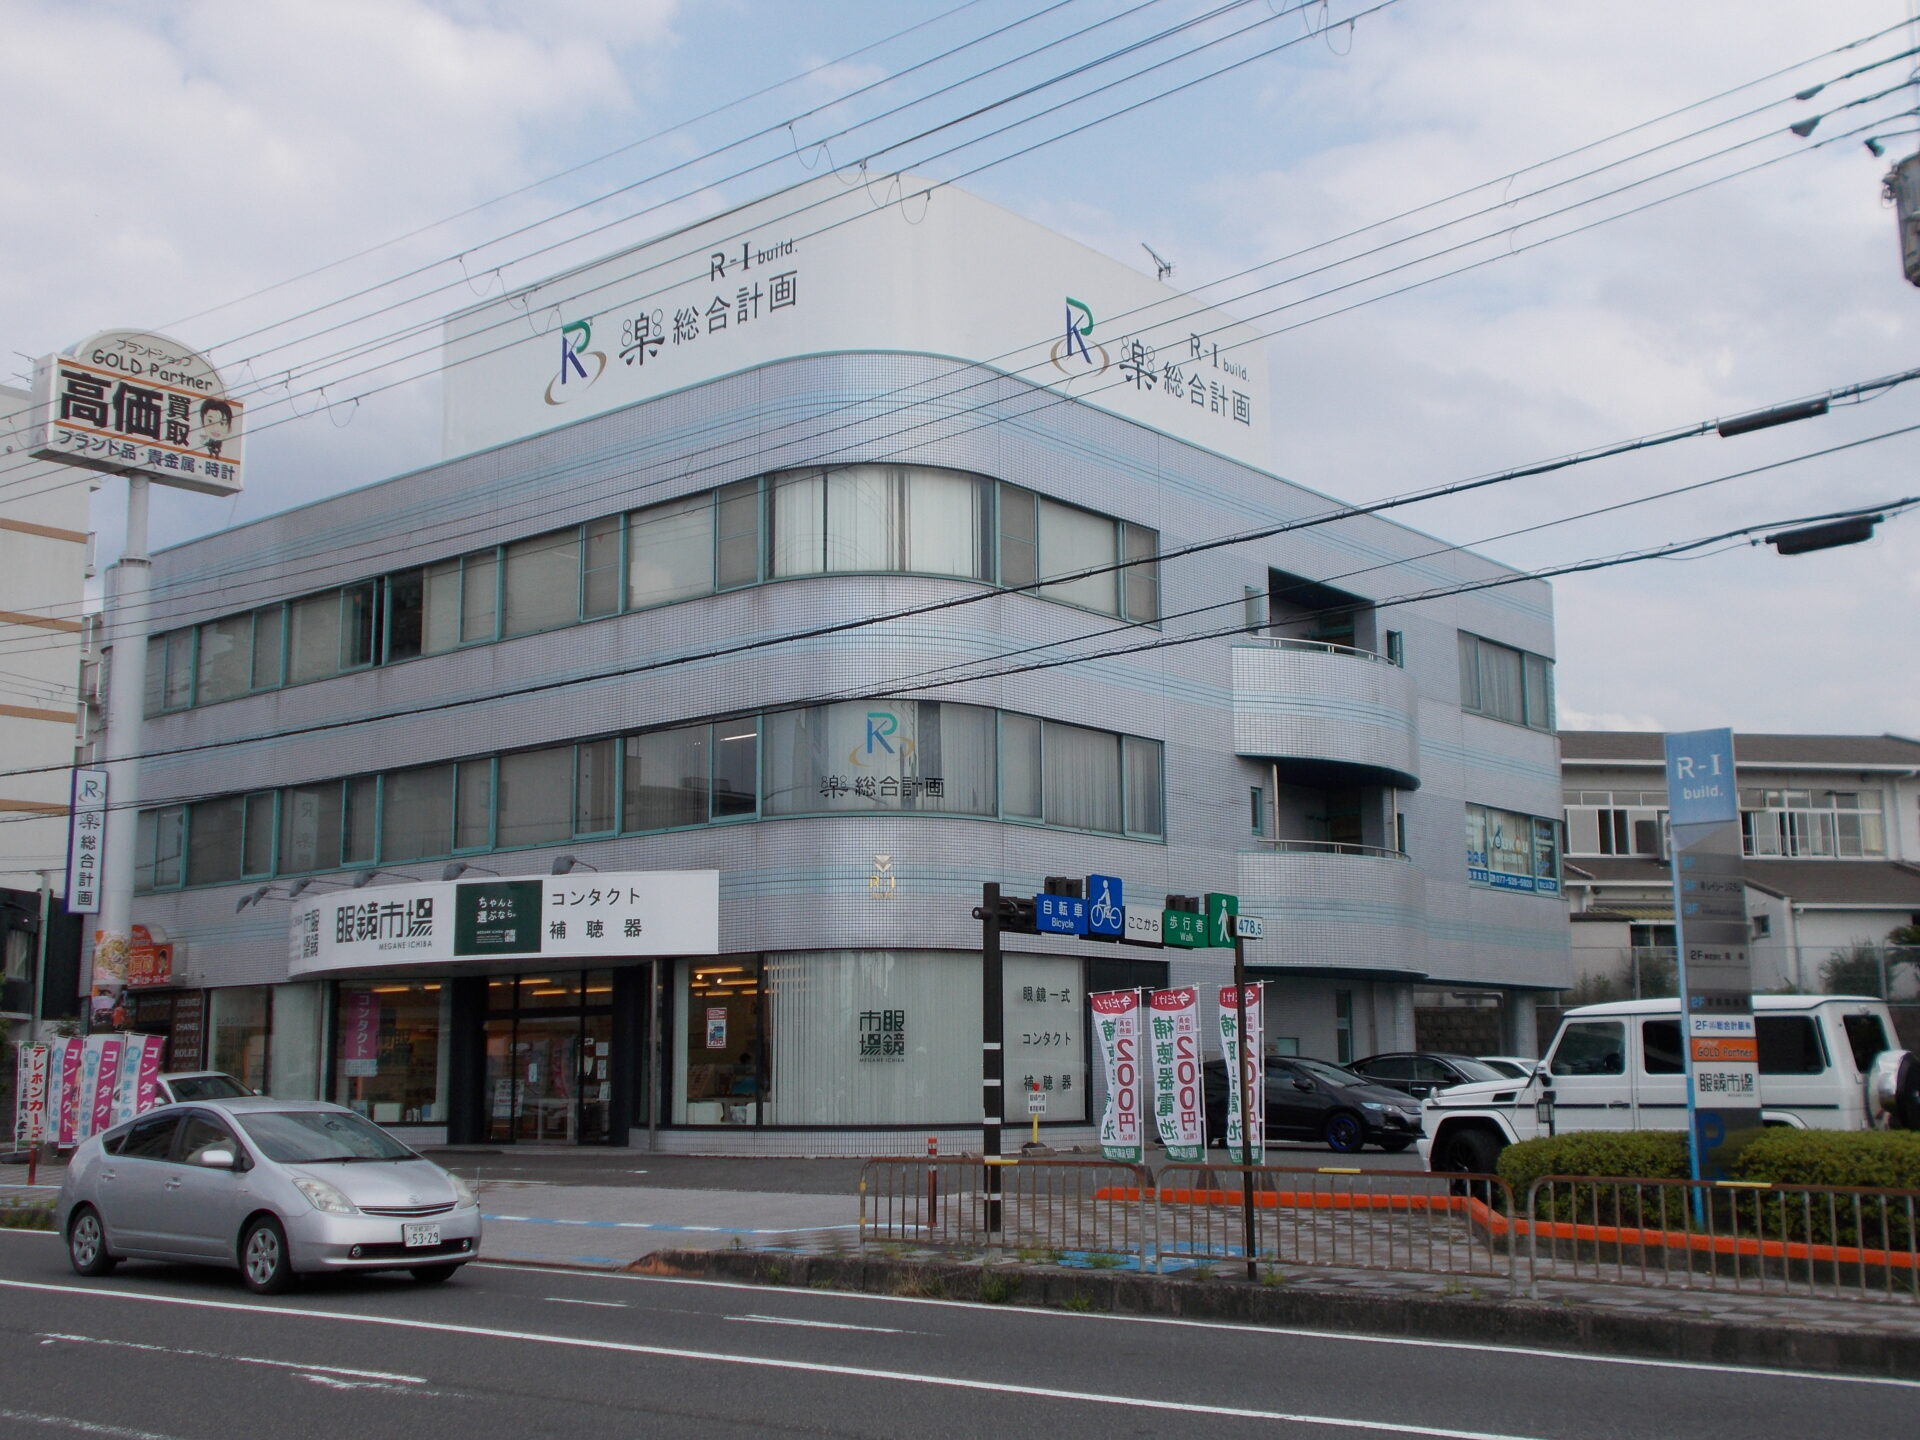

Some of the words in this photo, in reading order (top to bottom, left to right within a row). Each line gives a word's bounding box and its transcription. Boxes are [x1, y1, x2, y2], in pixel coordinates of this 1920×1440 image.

[757, 238, 798, 265] build.
[91, 349, 142, 374] GOLD
[150, 364, 213, 391] Partner
[1223, 357, 1250, 382] build.
[61, 369, 163, 440] 高価
[166, 394, 191, 447] 買取
[1677, 754, 1722, 779] R-I
[1683, 785, 1724, 799] build.
[478, 896, 513, 908] ちゃんと
[552, 888, 640, 906] コンタクト
[1043, 900, 1083, 917] 自転車
[336, 898, 433, 943] 眼鏡市場
[550, 918, 643, 939] 補聴器
[1051, 917, 1074, 929] Bicycle
[1128, 917, 1159, 931] ここから
[1169, 915, 1204, 933] 歩行者
[1239, 919, 1262, 935] 478.5
[1179, 932, 1194, 942] Walk
[1690, 950, 1703, 960] 2F
[1023, 986, 1071, 1003] 眼鏡一式
[357, 996, 369, 1056] コンタクト
[1695, 1020, 1708, 1030] 2F
[1023, 1033, 1071, 1046] コンタクト
[1698, 1046, 1720, 1057] GOLD
[1699, 1073, 1754, 1092] 眼鏡市場
